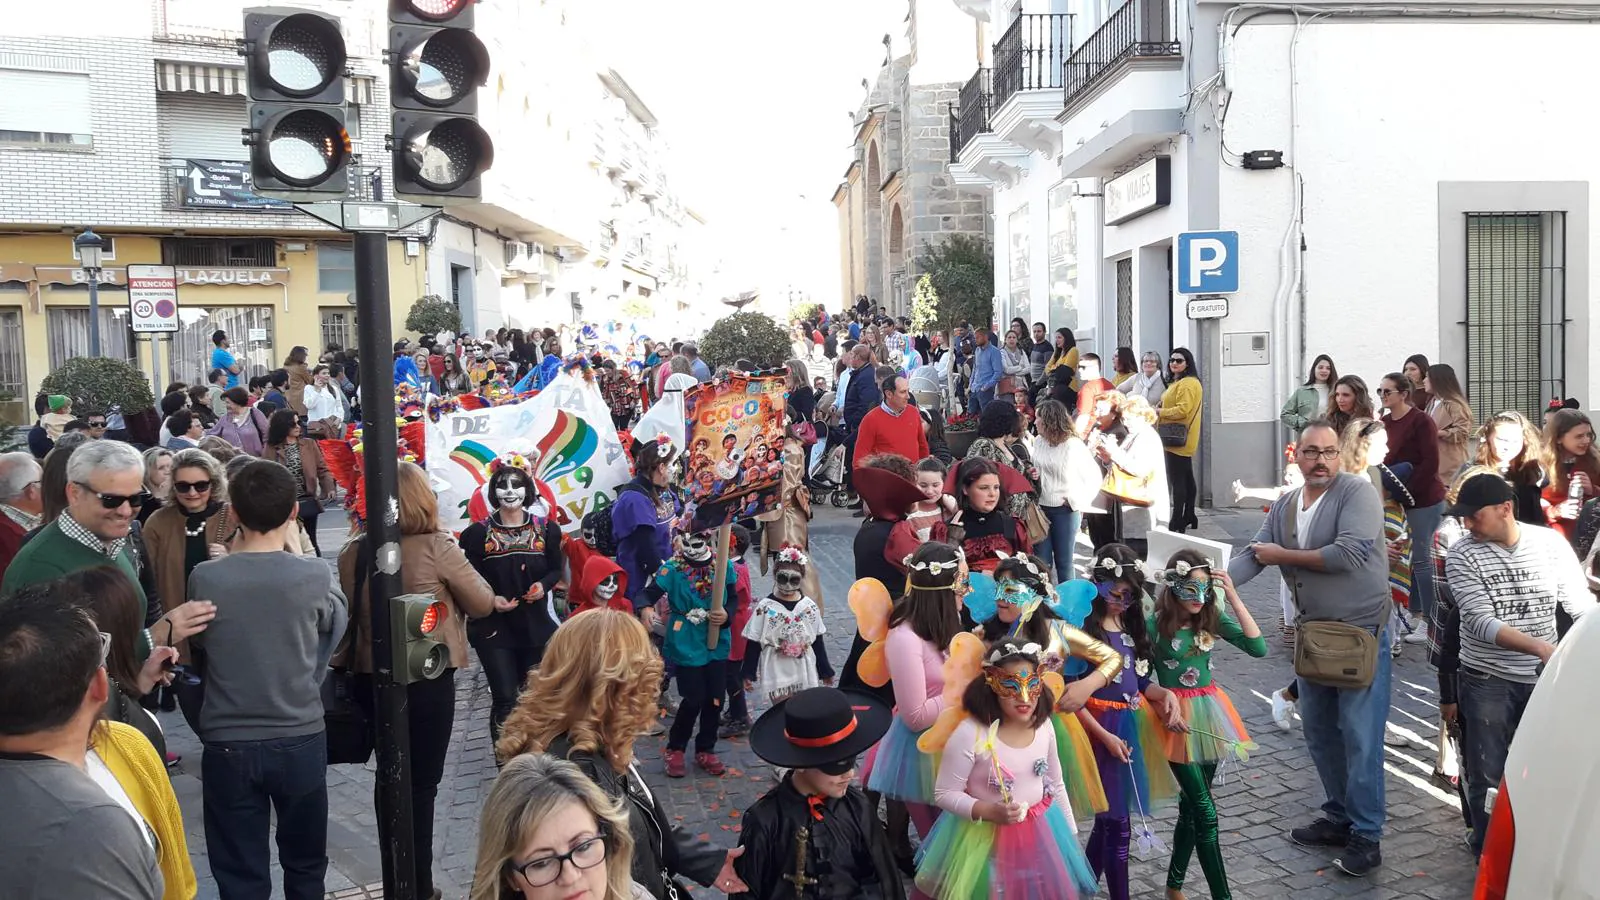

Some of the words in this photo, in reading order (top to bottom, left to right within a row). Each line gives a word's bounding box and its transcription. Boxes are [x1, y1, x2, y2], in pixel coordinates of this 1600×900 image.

[1126, 173, 1150, 203] VIAJES
[1189, 238, 1227, 287] P
[132, 280, 173, 288] ATENCIÓN
[138, 305, 150, 313] 20
[1197, 305, 1225, 313] GRATUITO
[701, 399, 759, 426] COCO
[451, 414, 491, 437] DE
